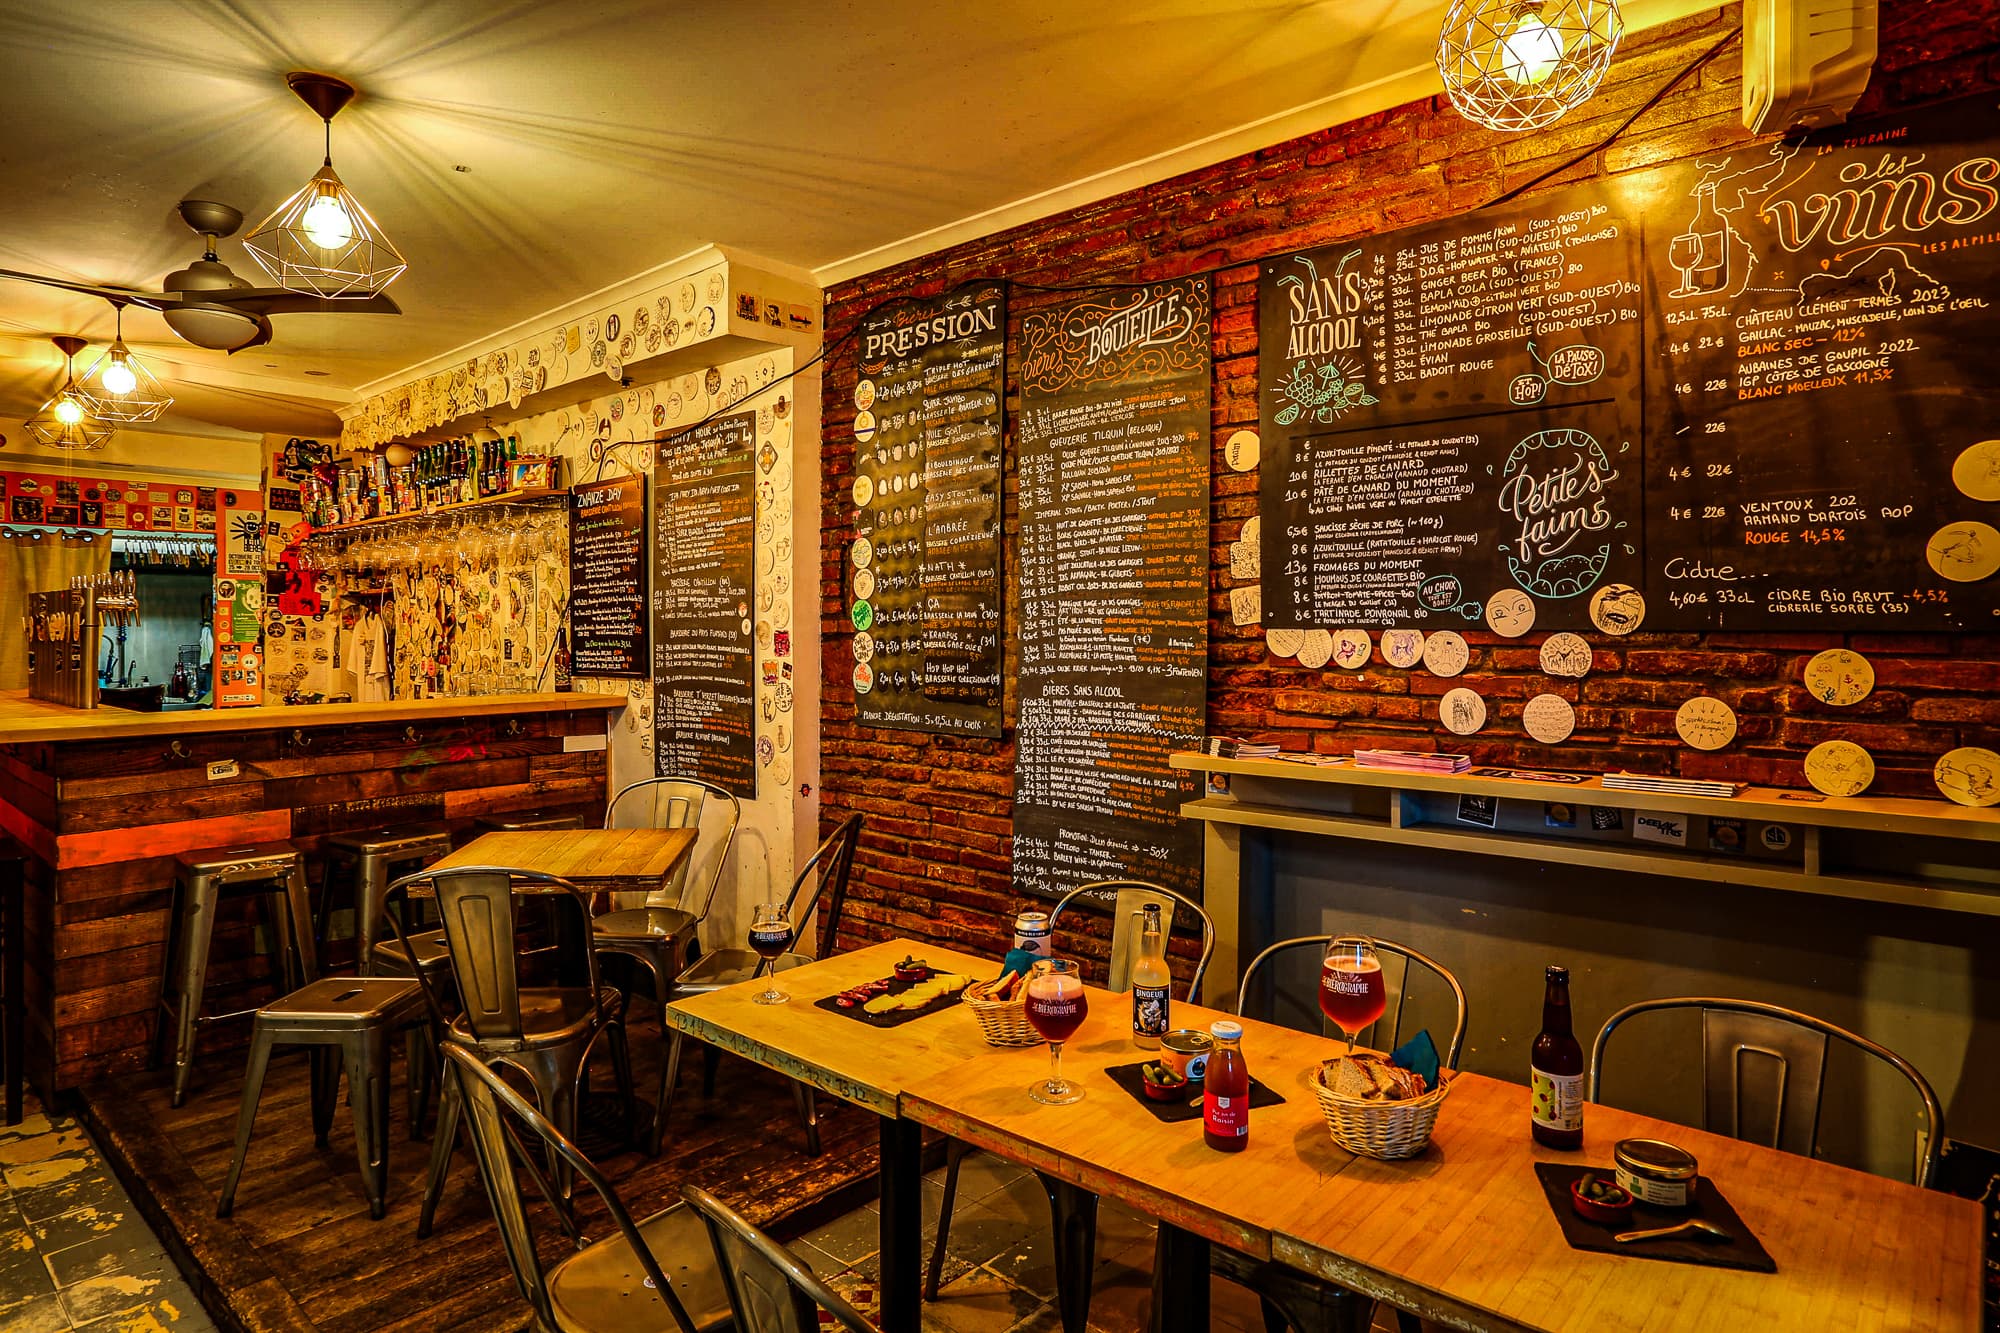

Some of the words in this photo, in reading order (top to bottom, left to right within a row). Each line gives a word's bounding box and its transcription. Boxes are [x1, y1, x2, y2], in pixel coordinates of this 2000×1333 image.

[1818, 144, 1834, 156] LA
[1844, 127, 1908, 150] TOURAINE
[1764, 157, 2000, 252] vins
[1420, 254, 1438, 266] JUS
[1445, 250, 1457, 261] DE
[1461, 242, 1493, 257] RAISIN
[1496, 226, 1560, 251] (SUD-OUEST)
[1420, 243, 1438, 255] JUS
[1443, 240, 1457, 251] DE
[1520, 240, 1563, 257] AVIATEUR
[1565, 226, 1618, 247] (TOULOUSE)
[1922, 241, 1948, 254] LES
[1421, 276, 1456, 291] GINGER
[1461, 269, 1488, 283] BEER
[1513, 252, 1565, 273] (FRANCE)
[1420, 288, 1453, 304] BAPLA
[1457, 282, 1486, 295] COLA
[1489, 266, 1564, 290] (SUD-OUEST)
[1517, 296, 1544, 311] VERT
[1547, 280, 1623, 306] (SUD-OUEST)
[1289, 270, 1362, 326] SANS
[1736, 306, 1794, 330] CHÂTEAU
[1799, 296, 1850, 317] CLÉMENT
[1853, 293, 1902, 310] TERMES
[1910, 286, 1951, 304] 2023
[1070, 288, 1192, 365] BOUTEILLE
[1441, 324, 1468, 336] BAPLA
[1518, 299, 1597, 325] (SUD-OUEST)
[1536, 309, 1617, 336] (SUD-OUEST)
[1620, 309, 1637, 320] BIO
[1739, 328, 1785, 343] GAILLAC
[1928, 301, 1945, 313] DE
[865, 305, 996, 359] PRESSION
[1286, 315, 1361, 360] ALCOOL
[1738, 341, 1780, 358] BLANC
[1784, 336, 1814, 350] SEC
[1832, 326, 1866, 343] 12%
[1420, 352, 1449, 366] ÉVIAN
[1554, 355, 1565, 364] LA
[1738, 358, 1793, 375] AUBAINES
[1799, 353, 1818, 366] DE
[1825, 347, 1871, 362] GOUPIL
[1876, 338, 1921, 356] 2022
[1420, 364, 1455, 379] BADOIT
[1460, 360, 1494, 373] ROUGE
[1704, 379, 1728, 392] 22€
[1739, 374, 1759, 388] IGP
[1765, 367, 1800, 384] CÔTES
[1802, 366, 1821, 379] DE
[1826, 357, 1890, 375] GASCOGNE
[1517, 377, 1532, 385] ET
[1738, 385, 1783, 400] BLANC
[1787, 377, 1847, 395] MOELLEUX
[1853, 368, 1894, 385] 11,5%
[1705, 422, 1726, 434] 22€
[1314, 466, 1361, 479] RILLETTES
[1364, 465, 1377, 474] DE
[1380, 460, 1424, 473] CANARD
[1323, 476, 1344, 484] FERME
[1431, 463, 1468, 475] CHOTARD)
[1706, 464, 1733, 477] 22€
[606, 487, 622, 501] DAY
[1314, 485, 1334, 496] PÂTÉ
[1337, 486, 1348, 494] DE
[1352, 481, 1391, 493] CANARD
[1397, 481, 1409, 490] DU
[1414, 475, 1459, 489] MOMENT
[1323, 495, 1344, 503] FERME
[1434, 482, 1474, 495] CHOTARD)
[1498, 453, 1621, 523] Petites
[1702, 506, 1726, 519] 22€
[1740, 498, 1814, 514] VENTOUX
[1744, 513, 1800, 526] ARMAND
[1881, 505, 1914, 518] AOP
[1514, 496, 1613, 564] faims
[1745, 531, 1791, 545] ROUGE
[927, 561, 954, 572] NATH
[1314, 562, 1360, 572] FROMAGES
[1364, 562, 1376, 570] DU
[1380, 560, 1422, 569] MOMENT
[1350, 574, 1360, 582] DE
[1363, 572, 1409, 582] COURGETTES
[1423, 586, 1433, 596] AU
[1669, 590, 1709, 610] 4,60€
[1852, 591, 1895, 603] BRUT
[1768, 602, 1824, 614] CIDRERIE
[1831, 603, 1876, 614] SORRE
[1882, 602, 1909, 615] (35)
[1074, 685, 1092, 696] SANS
[1095, 684, 1124, 698] ALCOOL
[1212, 1114, 1234, 1125] Raisin
